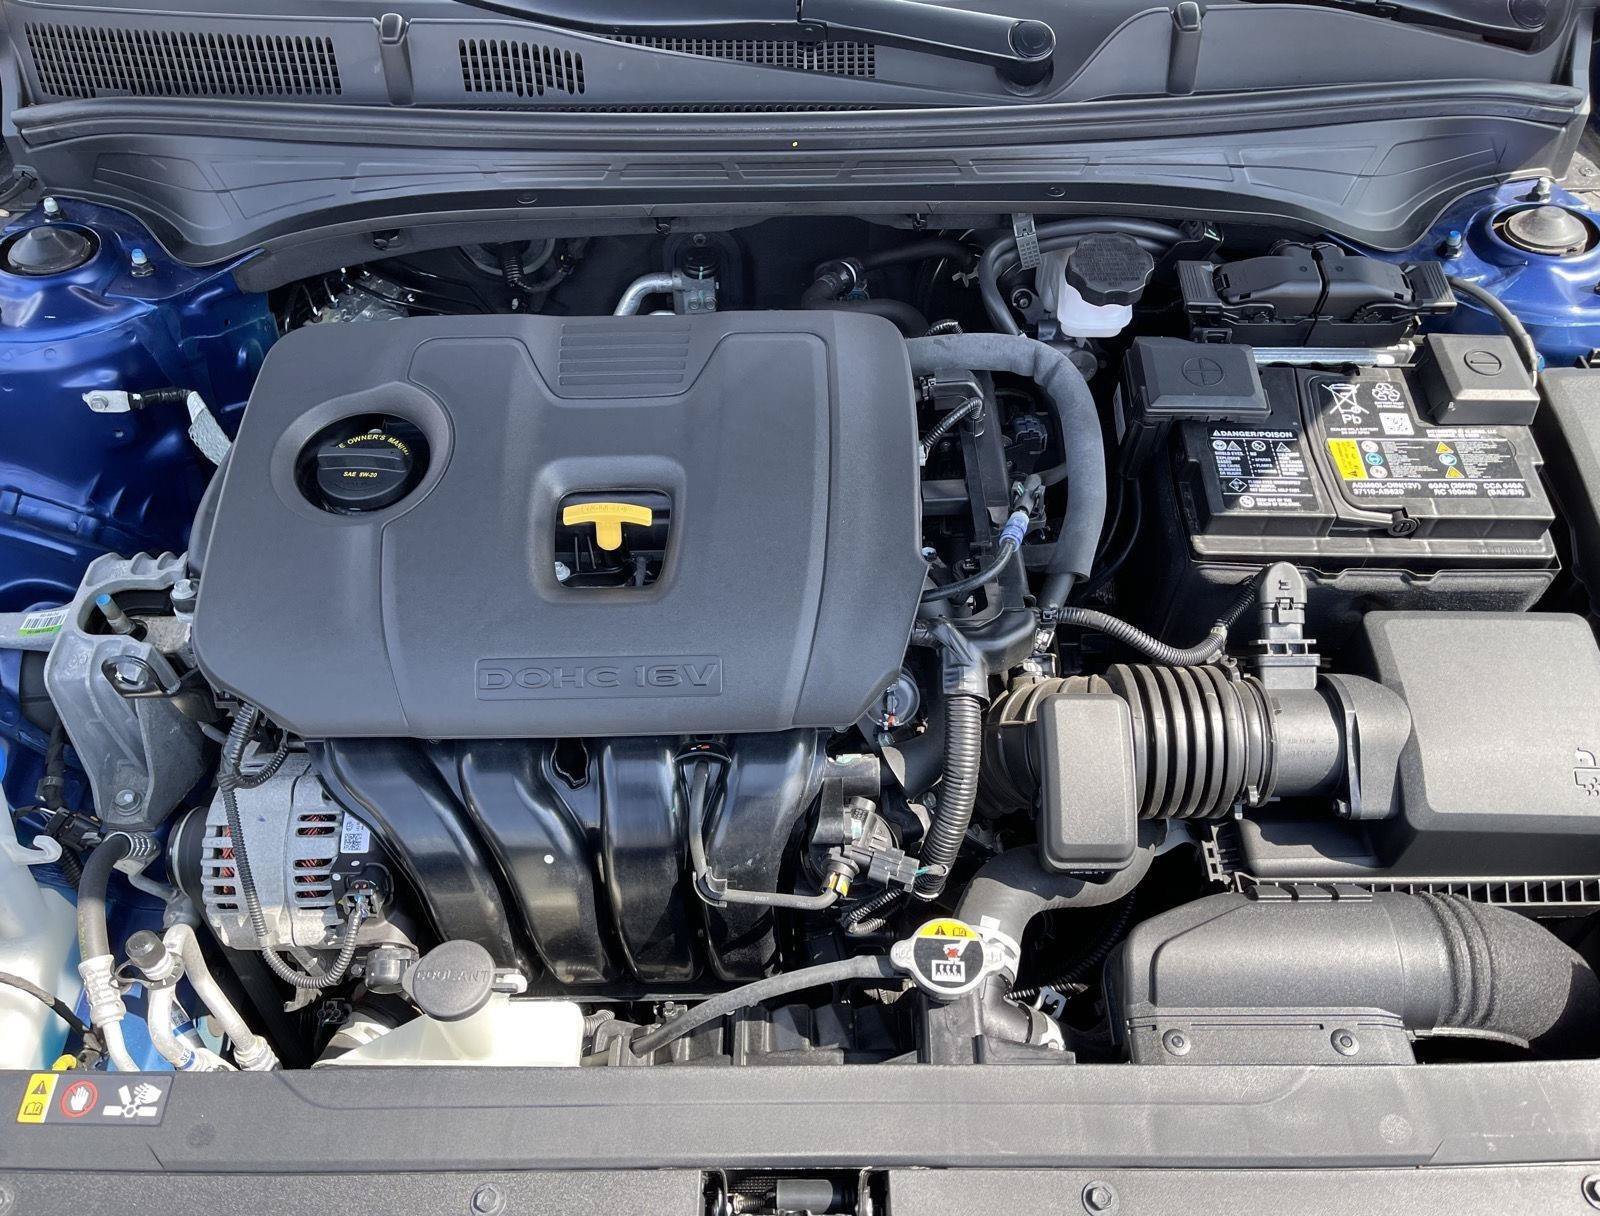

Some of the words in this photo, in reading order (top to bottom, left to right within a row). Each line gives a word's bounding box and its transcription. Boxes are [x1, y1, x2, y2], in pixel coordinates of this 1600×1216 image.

[1341, 413, 1362, 424] Pb
[347, 434, 387, 445] OWNER'S
[1220, 430, 1293, 438] DANGER/POISON
[479, 666, 622, 691] DOHC
[633, 663, 718, 687] 16V
